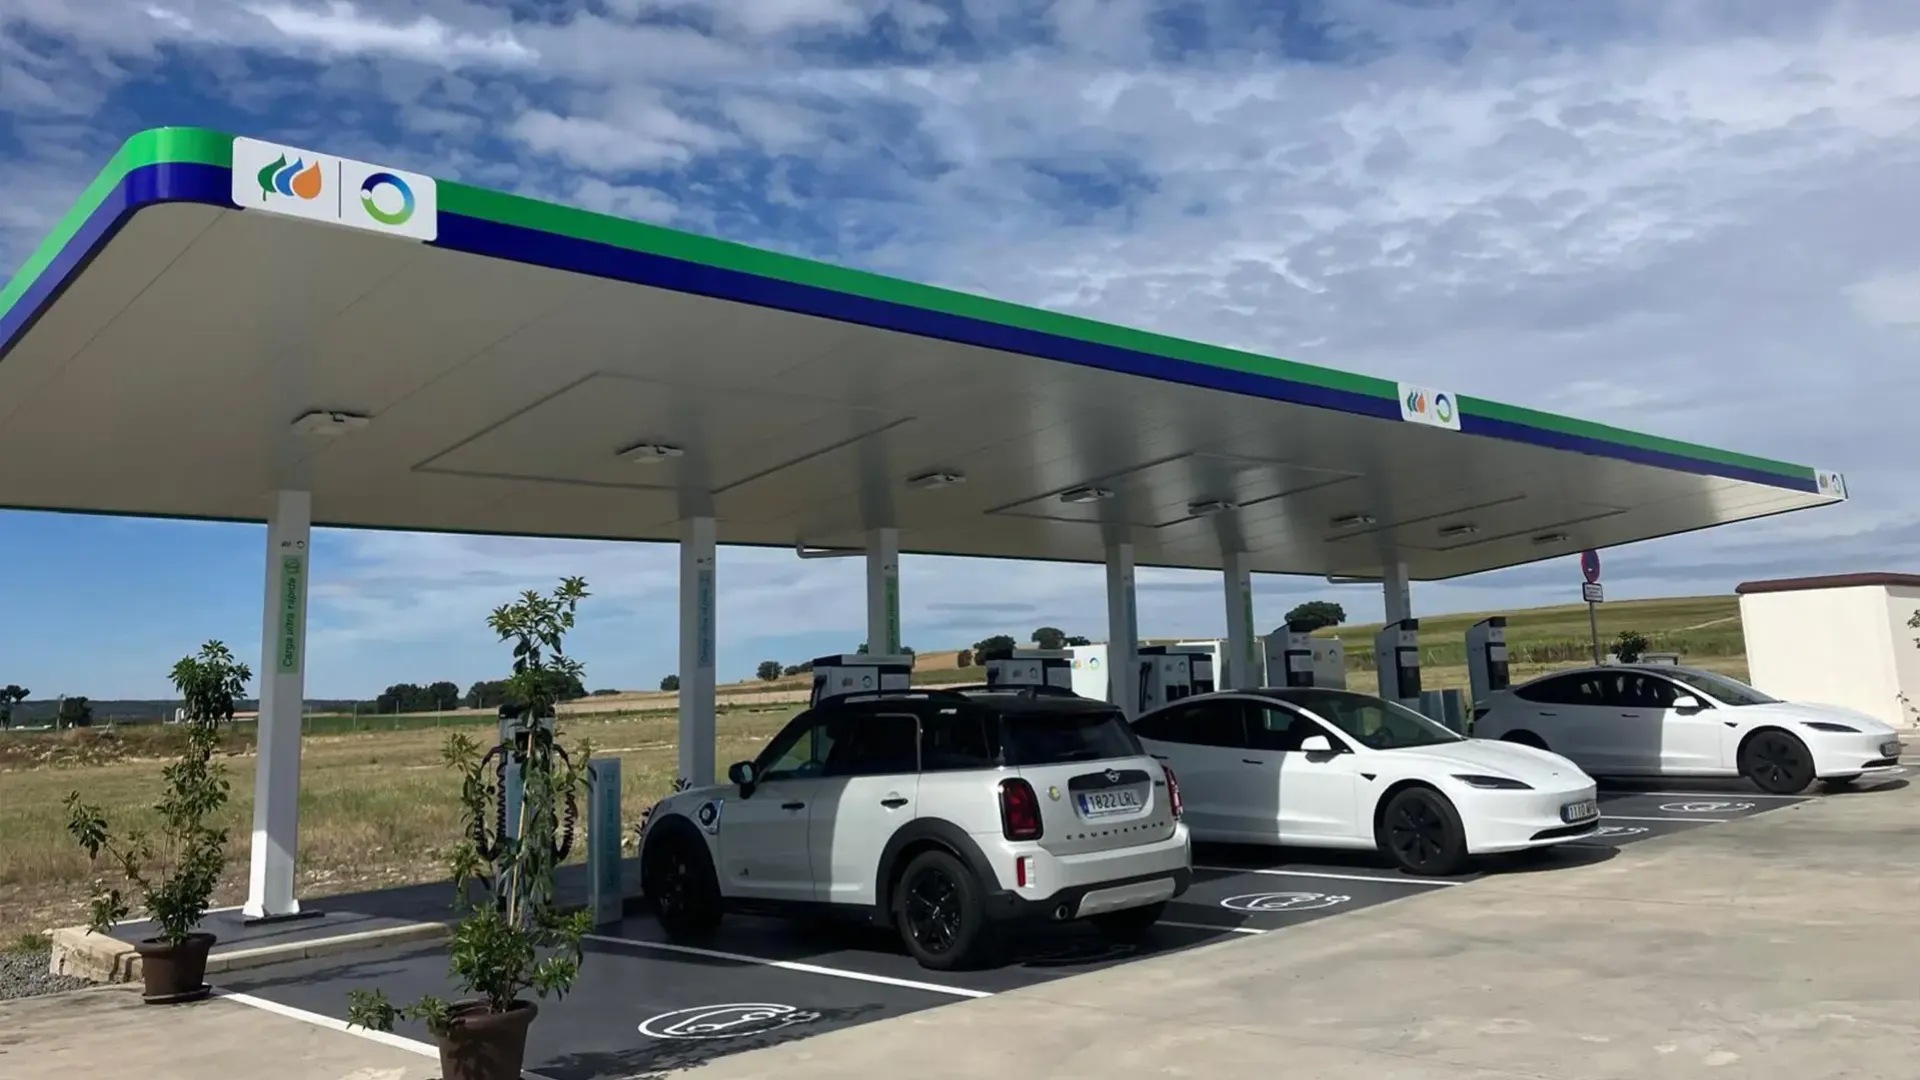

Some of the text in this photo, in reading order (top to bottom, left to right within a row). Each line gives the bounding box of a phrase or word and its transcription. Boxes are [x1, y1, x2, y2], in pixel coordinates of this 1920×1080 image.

[285, 613, 295, 635] ultra
[283, 637, 296, 667] Carga
[1089, 792, 1140, 810] 1822 LRL
